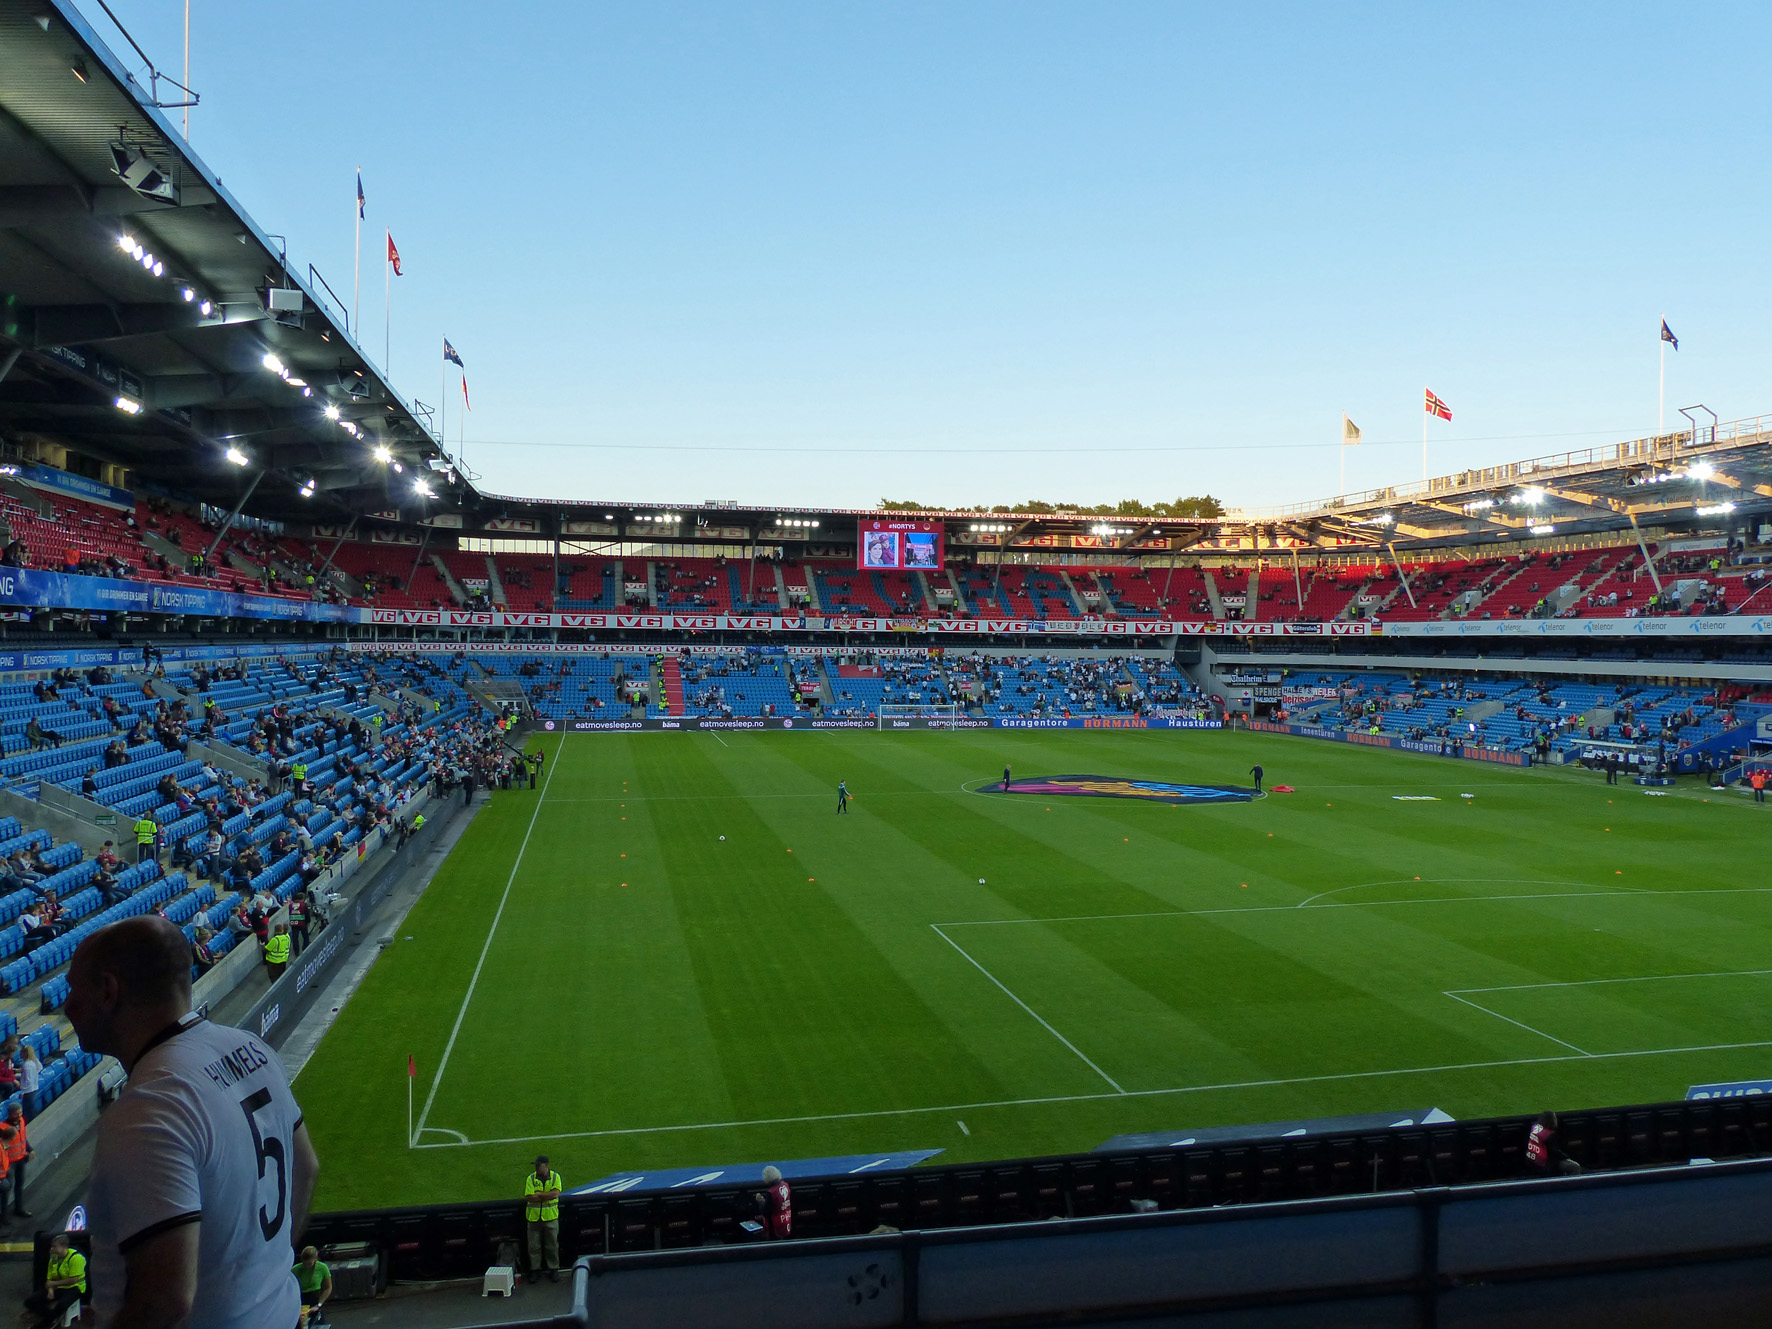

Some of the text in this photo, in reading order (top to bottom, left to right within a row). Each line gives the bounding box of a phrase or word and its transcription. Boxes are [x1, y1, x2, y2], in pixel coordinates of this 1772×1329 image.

[700, 527, 744, 537] VG
[761, 528, 805, 539] VG
[959, 534, 994, 544] VG
[1130, 538, 1166, 548] VG
[161, 591, 205, 608] NORSK TIPPING
[373, 611, 395, 622] VG
[405, 612, 440, 622] VG
[452, 614, 493, 624] VG
[505, 615, 550, 625] VG
[563, 616, 606, 626] VG
[619, 617, 662, 627] VG
[675, 618, 716, 627] VG
[730, 619, 771, 628] VG
[940, 622, 978, 631] VG
[990, 622, 1029, 631] VG
[1545, 622, 1565, 630] telenor
[1643, 622, 1667, 630] telenor
[1700, 621, 1726, 629] telenor
[1137, 624, 1173, 632] VG
[1234, 625, 1273, 633] VG
[1333, 625, 1364, 633] VG
[1592, 623, 1613, 631] telenor
[29, 653, 67, 665] NORSK TIPPING
[81, 652, 112, 663] NORSK TIPPING
[1255, 687, 1281, 697] SPENGE
[576, 721, 642, 730] eatmovesleep.no
[700, 720, 764, 729] eatmovesleep.no
[812, 719, 874, 728] eatmovesleep.no
[893, 719, 910, 727] bama
[928, 719, 988, 728] eatmovesleep.no
[1002, 719, 1068, 728] Garagentore
[1084, 719, 1148, 728] HÖRMANN
[1169, 719, 1222, 728] Haustüren
[1301, 726, 1335, 738] Innentüren
[1401, 739, 1451, 754] Garagentoe
[296, 926, 345, 993] eatmovesleep.no
[261, 1003, 280, 1038] bama
[240, 1086, 286, 1242] 5
